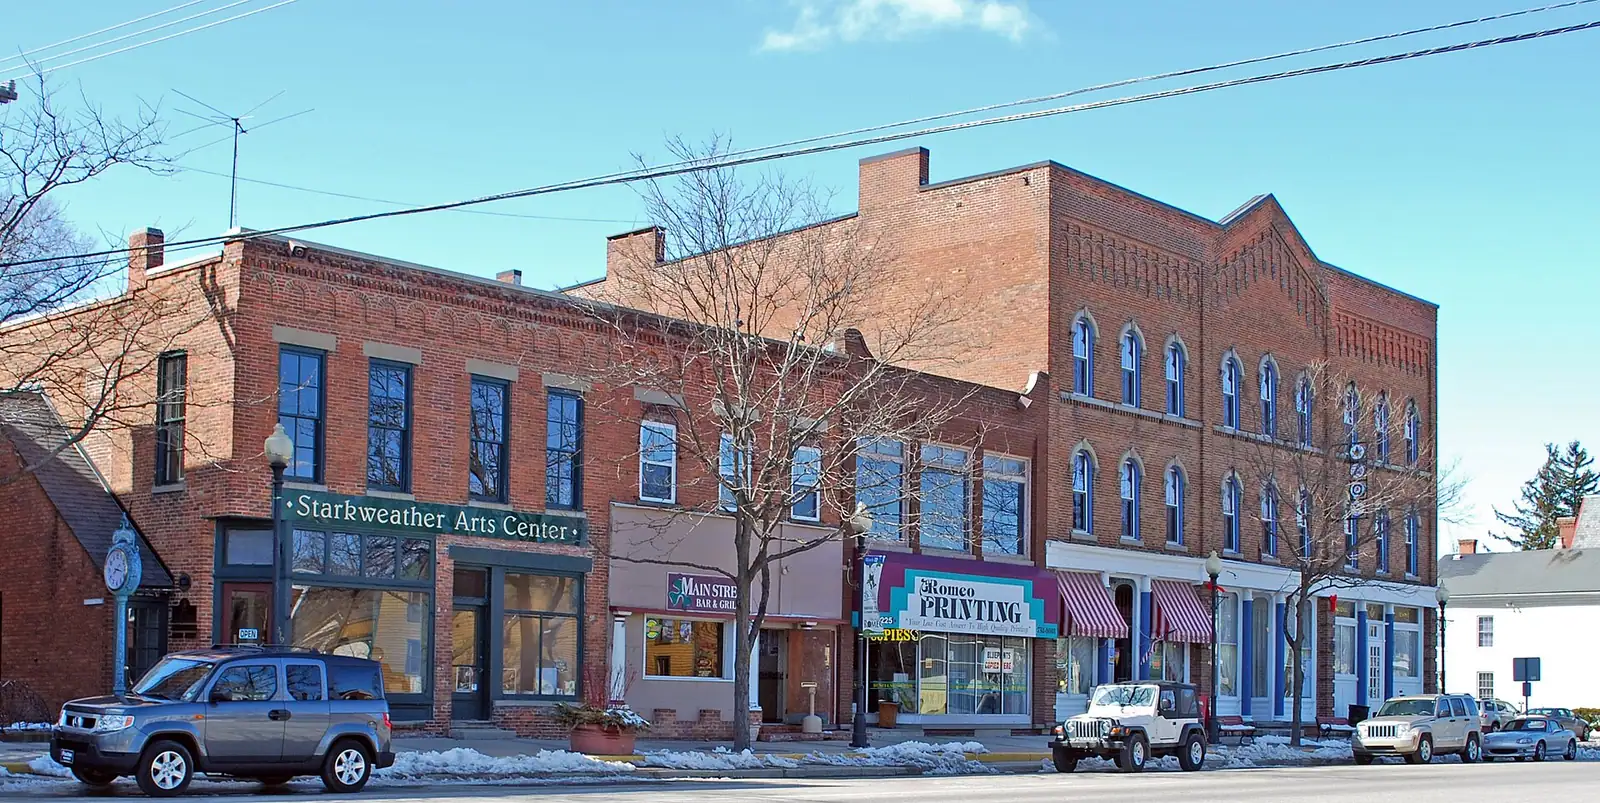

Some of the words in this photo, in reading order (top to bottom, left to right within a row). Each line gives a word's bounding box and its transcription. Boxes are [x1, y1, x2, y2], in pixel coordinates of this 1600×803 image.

[296, 495, 446, 529] Starkweather
[454, 511, 496, 534] Arts
[503, 516, 568, 540] Center
[681, 576, 711, 596] MAIN
[711, 585, 738, 599] STRE
[919, 578, 975, 597] Romeo
[696, 599, 712, 609] BAR
[712, 599, 718, 609] &
[720, 600, 737, 609] GRIL
[920, 596, 1022, 623] PRINTING
[880, 616, 893, 625] 225
[240, 630, 257, 638] OPEN
